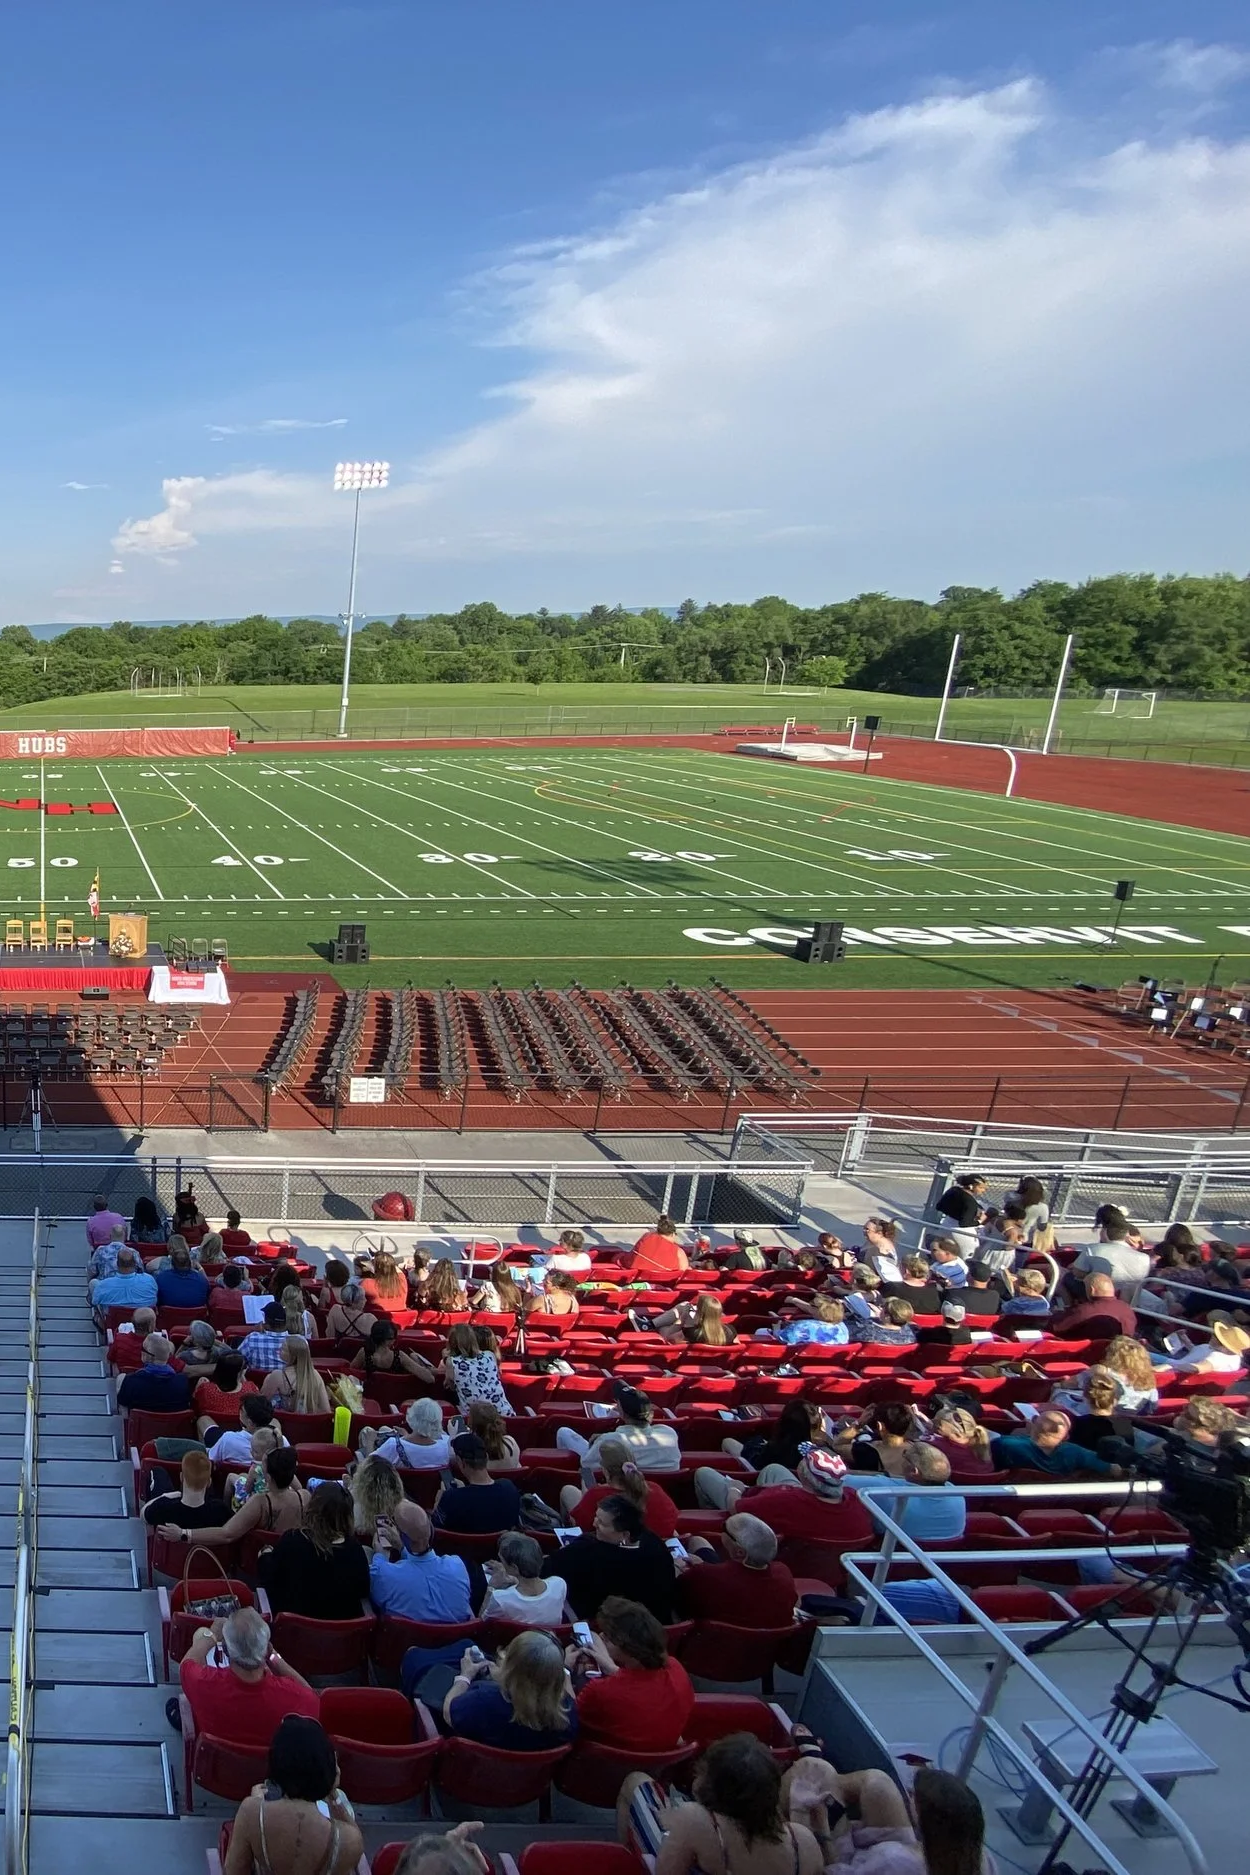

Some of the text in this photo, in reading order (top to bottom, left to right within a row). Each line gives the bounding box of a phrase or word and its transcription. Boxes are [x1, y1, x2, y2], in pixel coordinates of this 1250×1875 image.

[17, 736, 67, 754] HUBS
[211, 855, 284, 866] 40
[417, 853, 499, 864] 30
[628, 851, 716, 861] 20
[6, 857, 79, 868] 50
